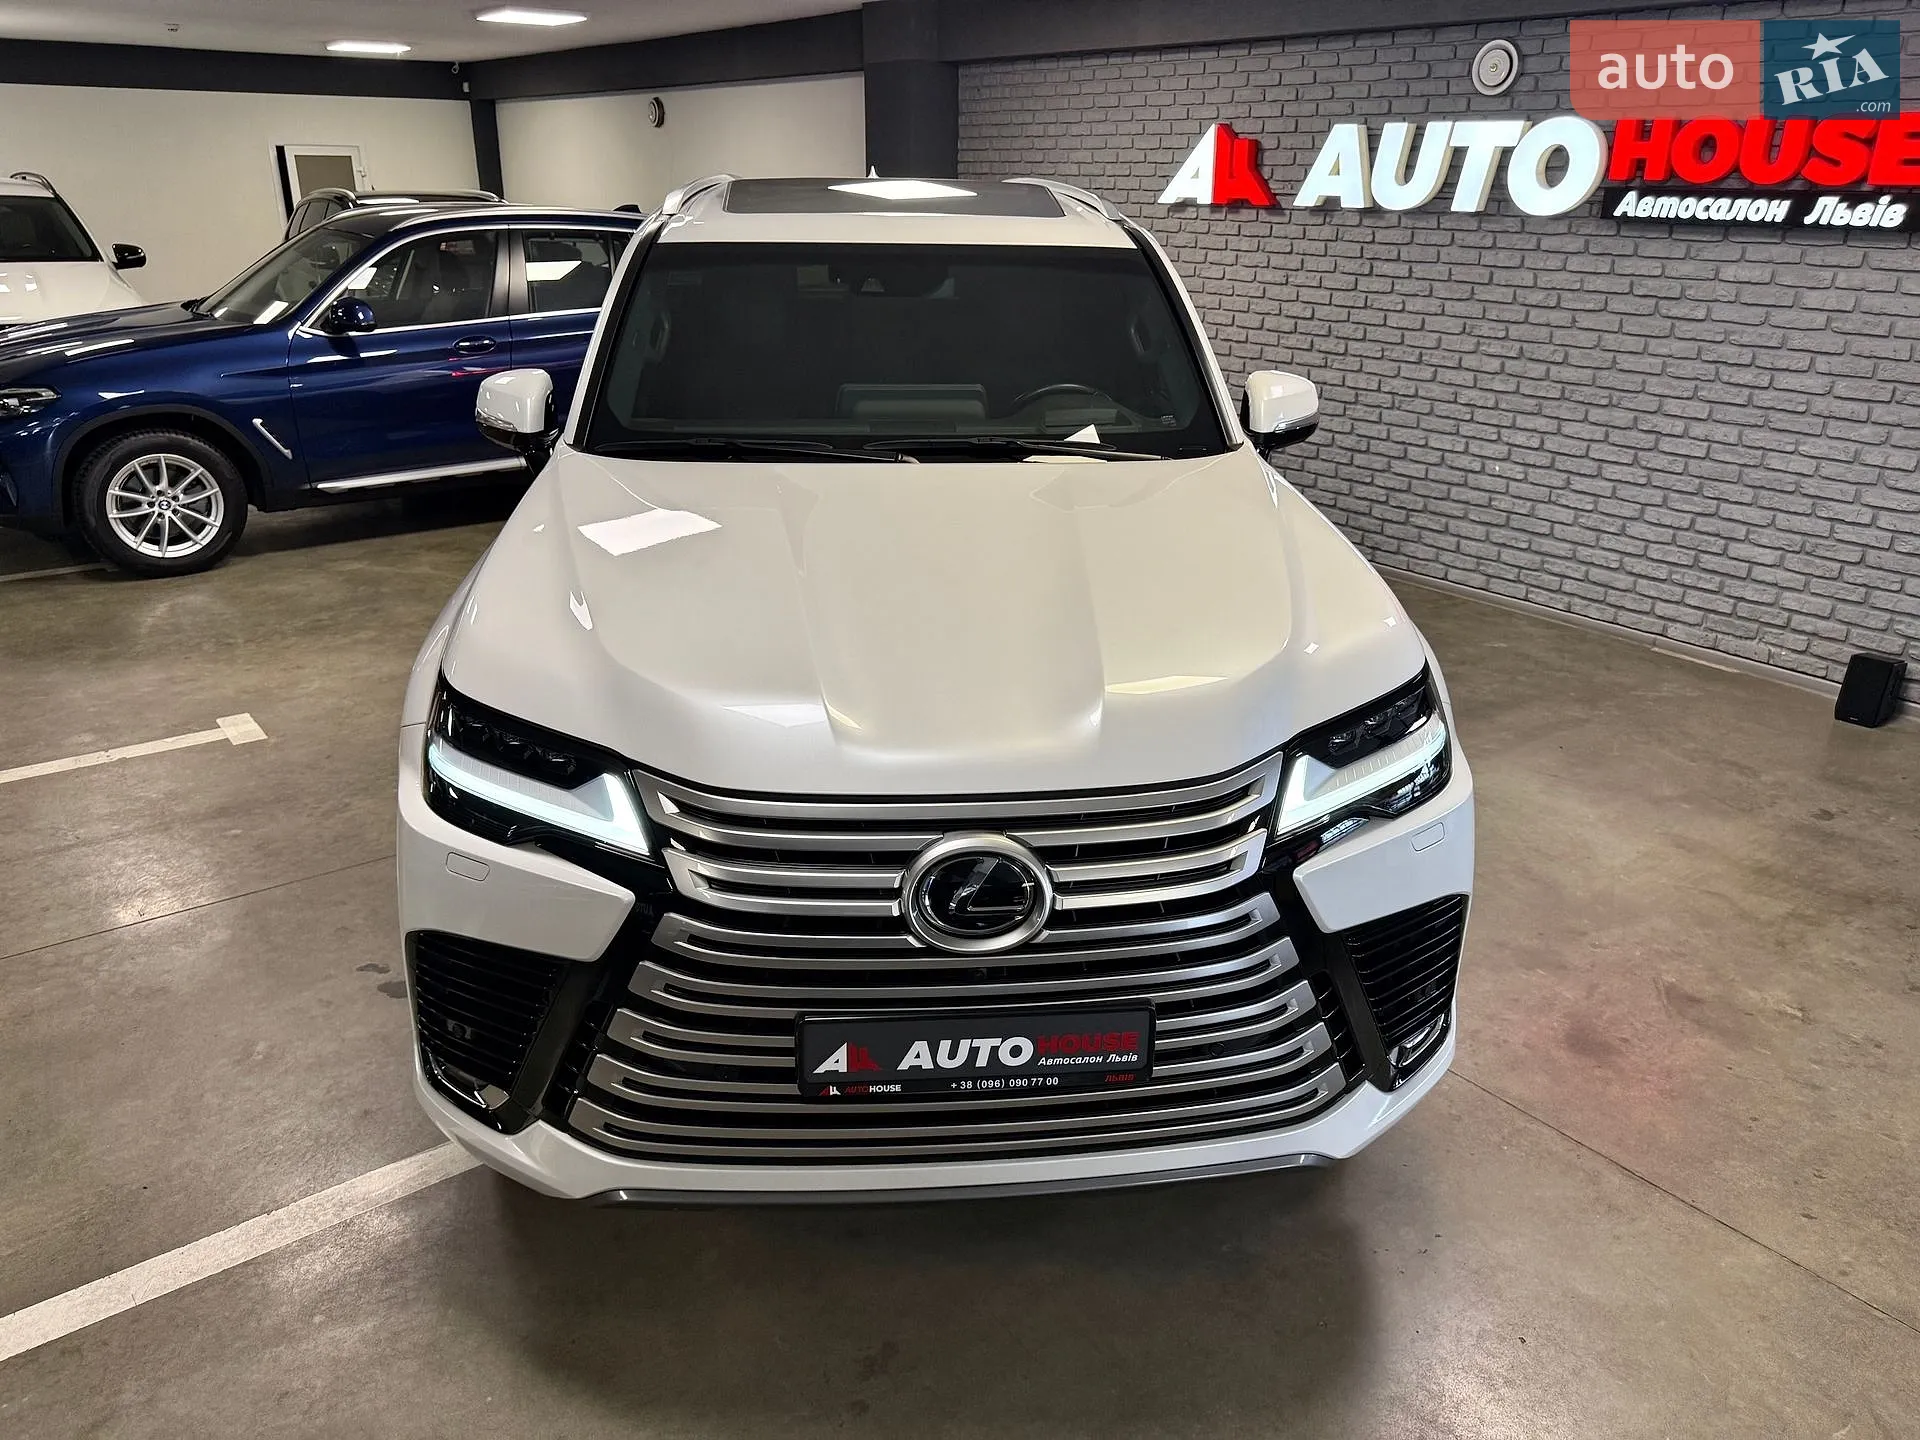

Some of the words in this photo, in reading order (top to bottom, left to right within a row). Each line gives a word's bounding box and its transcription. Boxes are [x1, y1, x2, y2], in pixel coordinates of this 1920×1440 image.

[1613, 191, 1788, 224] Автосалон
[1803, 196, 1905, 229] Львів
[1037, 1055, 1103, 1066] Автосалон
[1106, 1052, 1138, 1063] Львів
